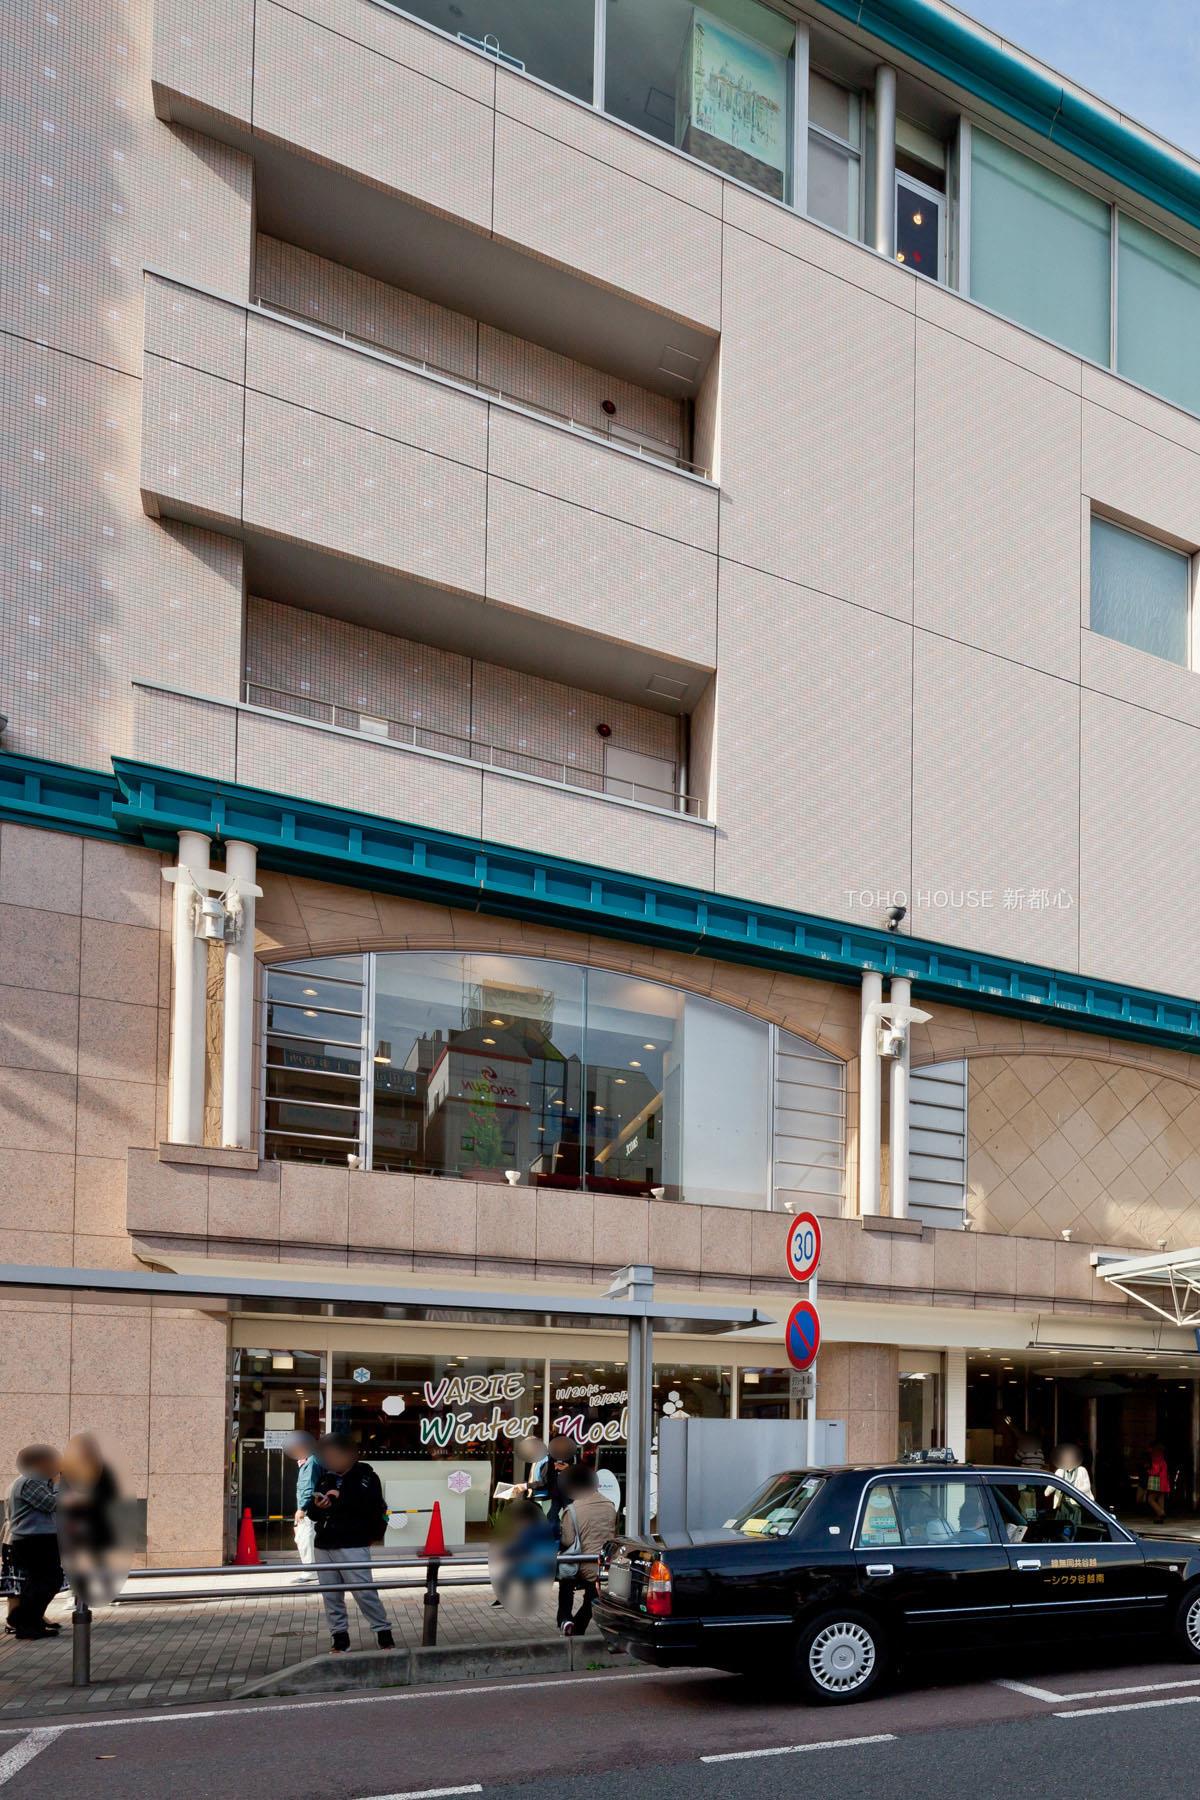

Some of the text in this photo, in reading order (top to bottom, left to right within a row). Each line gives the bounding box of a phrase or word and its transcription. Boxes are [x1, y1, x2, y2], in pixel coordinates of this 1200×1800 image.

[794, 1230, 814, 1263] 30
[424, 1373, 525, 1408] VARIE
[420, 1406, 539, 1448] Winter
